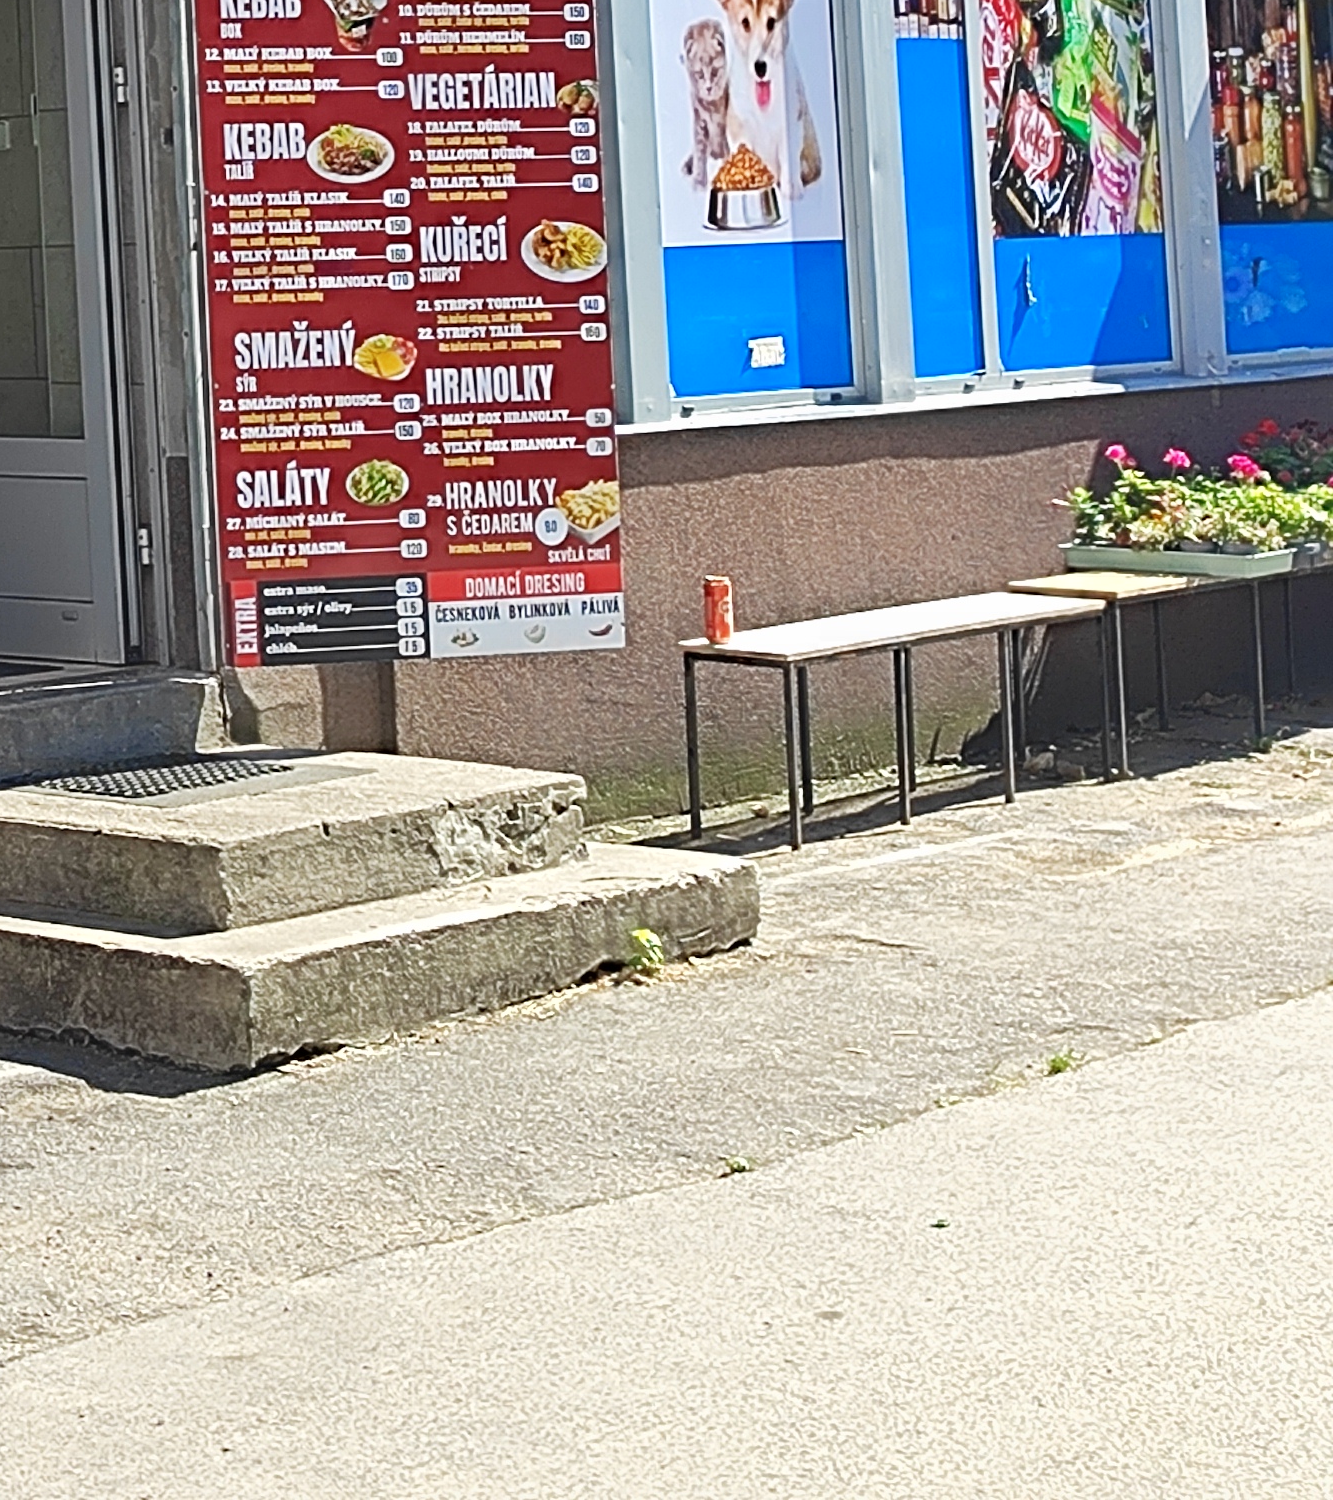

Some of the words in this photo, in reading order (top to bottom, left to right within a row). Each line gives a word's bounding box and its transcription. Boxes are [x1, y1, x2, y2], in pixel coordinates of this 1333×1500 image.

[569, 6, 585, 18] 150
[220, 22, 243, 39] BOX
[407, 63, 556, 110] VEGETÁRIAN
[223, 122, 306, 160] KEBAB
[224, 160, 254, 180] TALÍŘ
[419, 215, 508, 263] KUŘECÍ
[392, 273, 409, 286] 170
[419, 265, 462, 283] STRIPSY
[234, 319, 356, 370] SMAŽENÝ
[235, 372, 257, 393] SÝR
[425, 364, 553, 405] HRANOLKY
[236, 459, 331, 509] SALÁTY
[445, 477, 557, 510] HRANOLKY
[446, 515, 458, 536] S
[461, 509, 534, 536] ČEDAREM
[548, 545, 584, 563] SKVĚLÁ
[586, 544, 612, 561] CHUŤ
[465, 570, 522, 598] DOMACÍ
[525, 572, 585, 595] DRESING
[436, 602, 501, 623] ČESNEKOVÁ
[509, 598, 571, 620] BYLINKOVÁ
[581, 595, 620, 616] PÁLIVÁ
[234, 596, 259, 655] EXTRA
